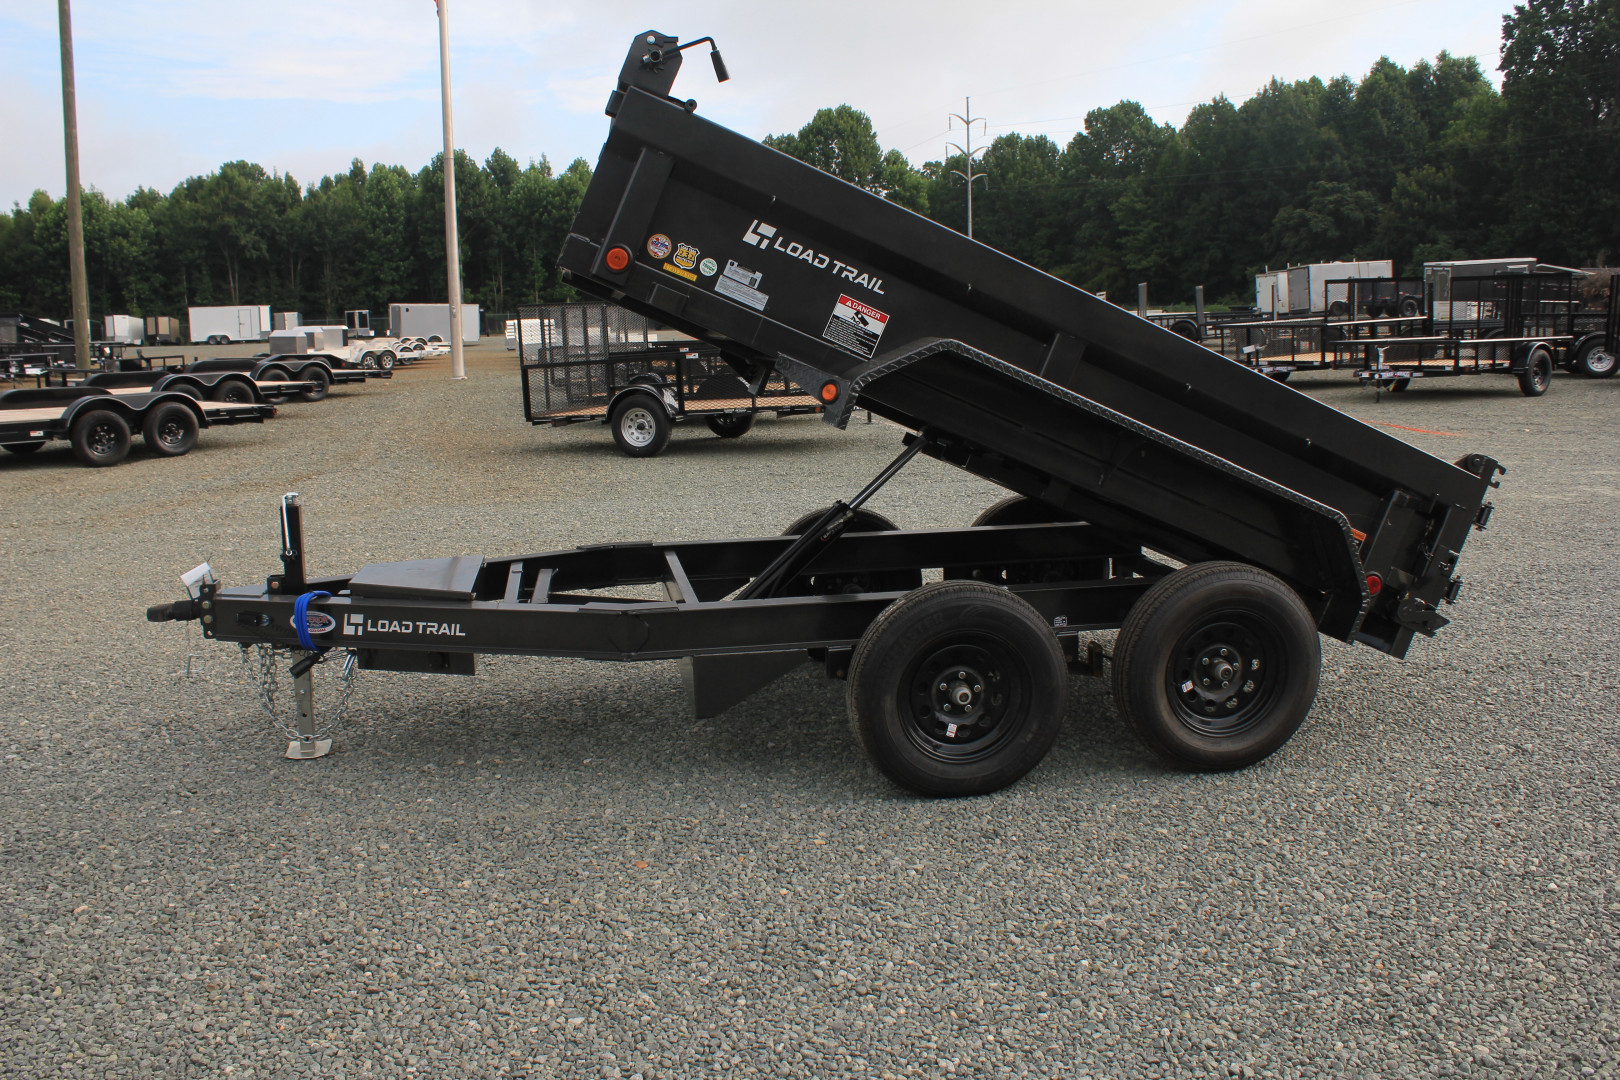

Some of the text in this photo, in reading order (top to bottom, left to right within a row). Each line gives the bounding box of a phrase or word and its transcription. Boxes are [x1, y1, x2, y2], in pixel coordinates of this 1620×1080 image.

[774, 237, 885, 295] LOAD TRAIL
[852, 302, 881, 320] DANGER
[367, 619, 466, 637] LOAD TRAIL
